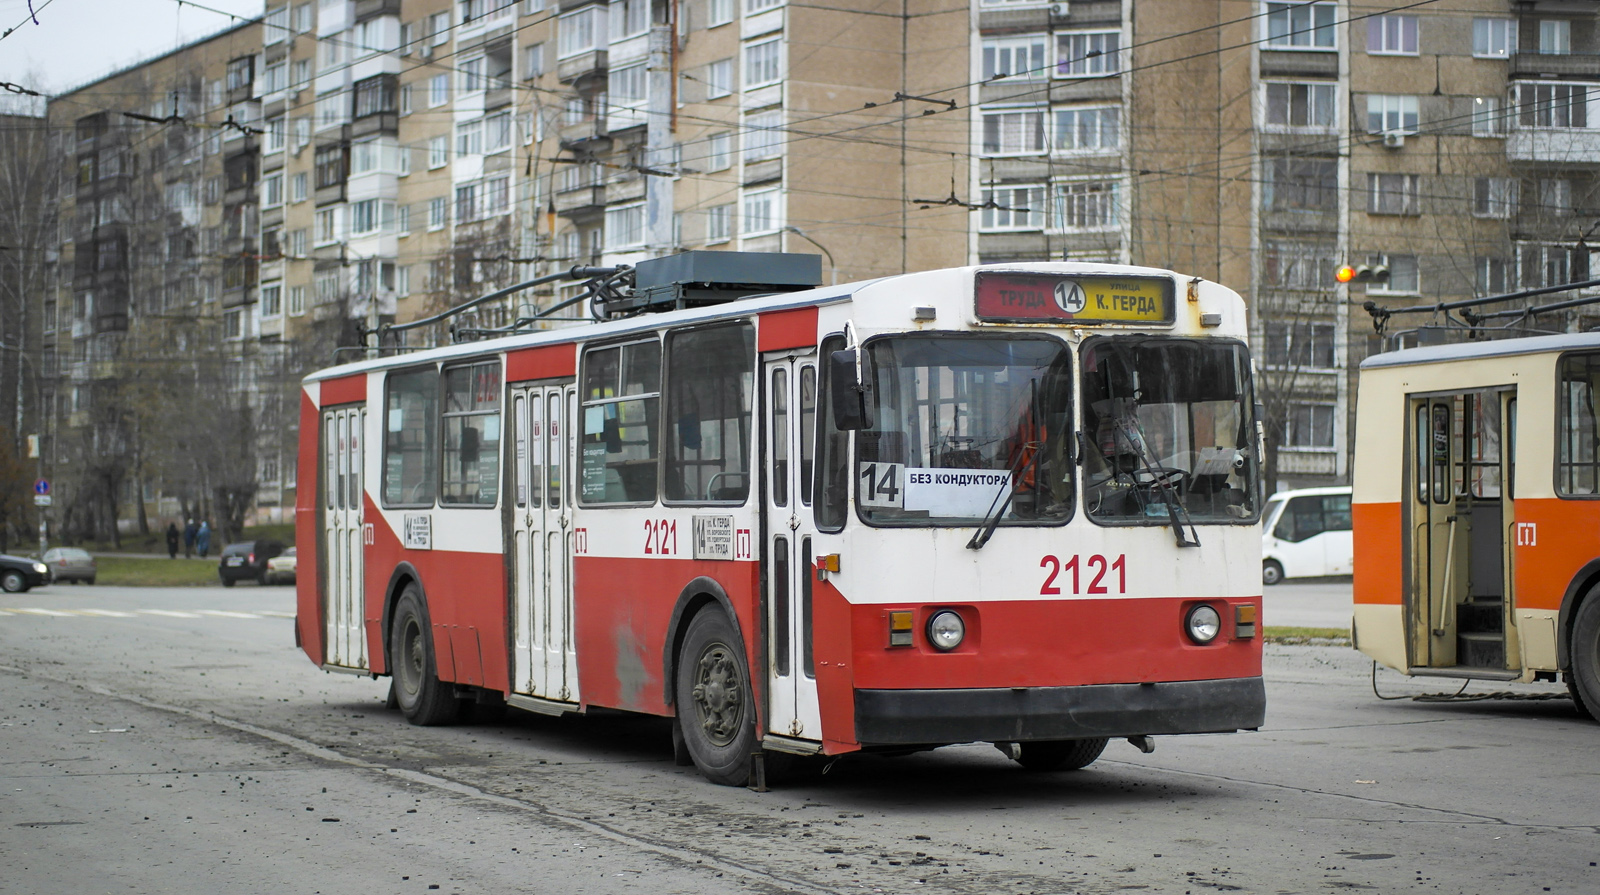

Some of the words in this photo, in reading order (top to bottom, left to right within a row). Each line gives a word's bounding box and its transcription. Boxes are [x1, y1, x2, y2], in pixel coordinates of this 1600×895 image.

[1055, 283, 1082, 309] 14
[1110, 283, 1141, 292] УЛИЦА
[1000, 290, 1046, 310] ТРУДА
[1096, 294, 1109, 310] К.
[1113, 295, 1156, 315] ГЕРДА
[861, 464, 899, 501] 14
[910, 474, 932, 484] БЕЗ
[935, 474, 1008, 486] КОНДУКТОРА
[717, 518, 730, 529] ГЕРДА
[644, 519, 677, 555] 2121
[696, 518, 706, 554] 14
[715, 544, 728, 555] ТРУДА
[1040, 554, 1125, 595] 2121
